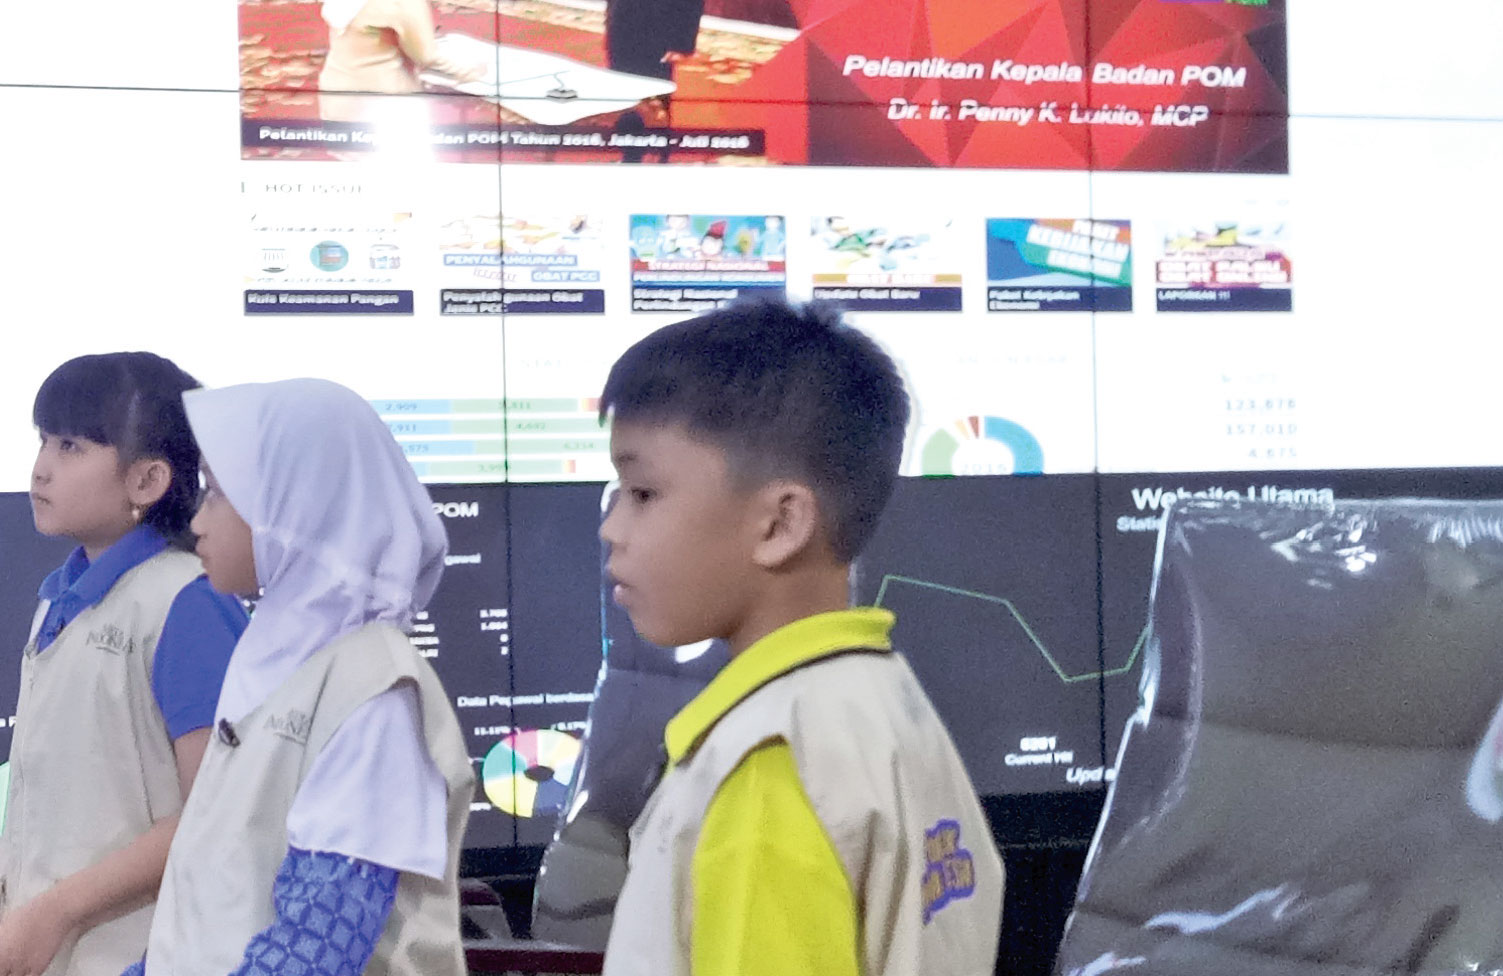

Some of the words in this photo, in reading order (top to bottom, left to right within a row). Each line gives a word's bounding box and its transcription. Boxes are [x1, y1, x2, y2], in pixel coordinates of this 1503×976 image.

[842, 54, 984, 79] Pelantikan
[991, 59, 1082, 84] Kepala
[1092, 62, 1174, 86] Badan
[1181, 66, 1247, 88] POM
[887, 97, 921, 121] Dr.
[958, 99, 1035, 126] Penny
[1037, 101, 1062, 123] K.
[1151, 105, 1209, 127] MCP
[259, 127, 347, 142] Pelantikan
[510, 131, 560, 145] Tahun
[608, 132, 667, 146] Jakarta
[279, 293, 349, 304] Keamanan
[350, 293, 399, 306] Pangan
[457, 696, 487, 707] Data
[1066, 767, 1116, 786] Upda
